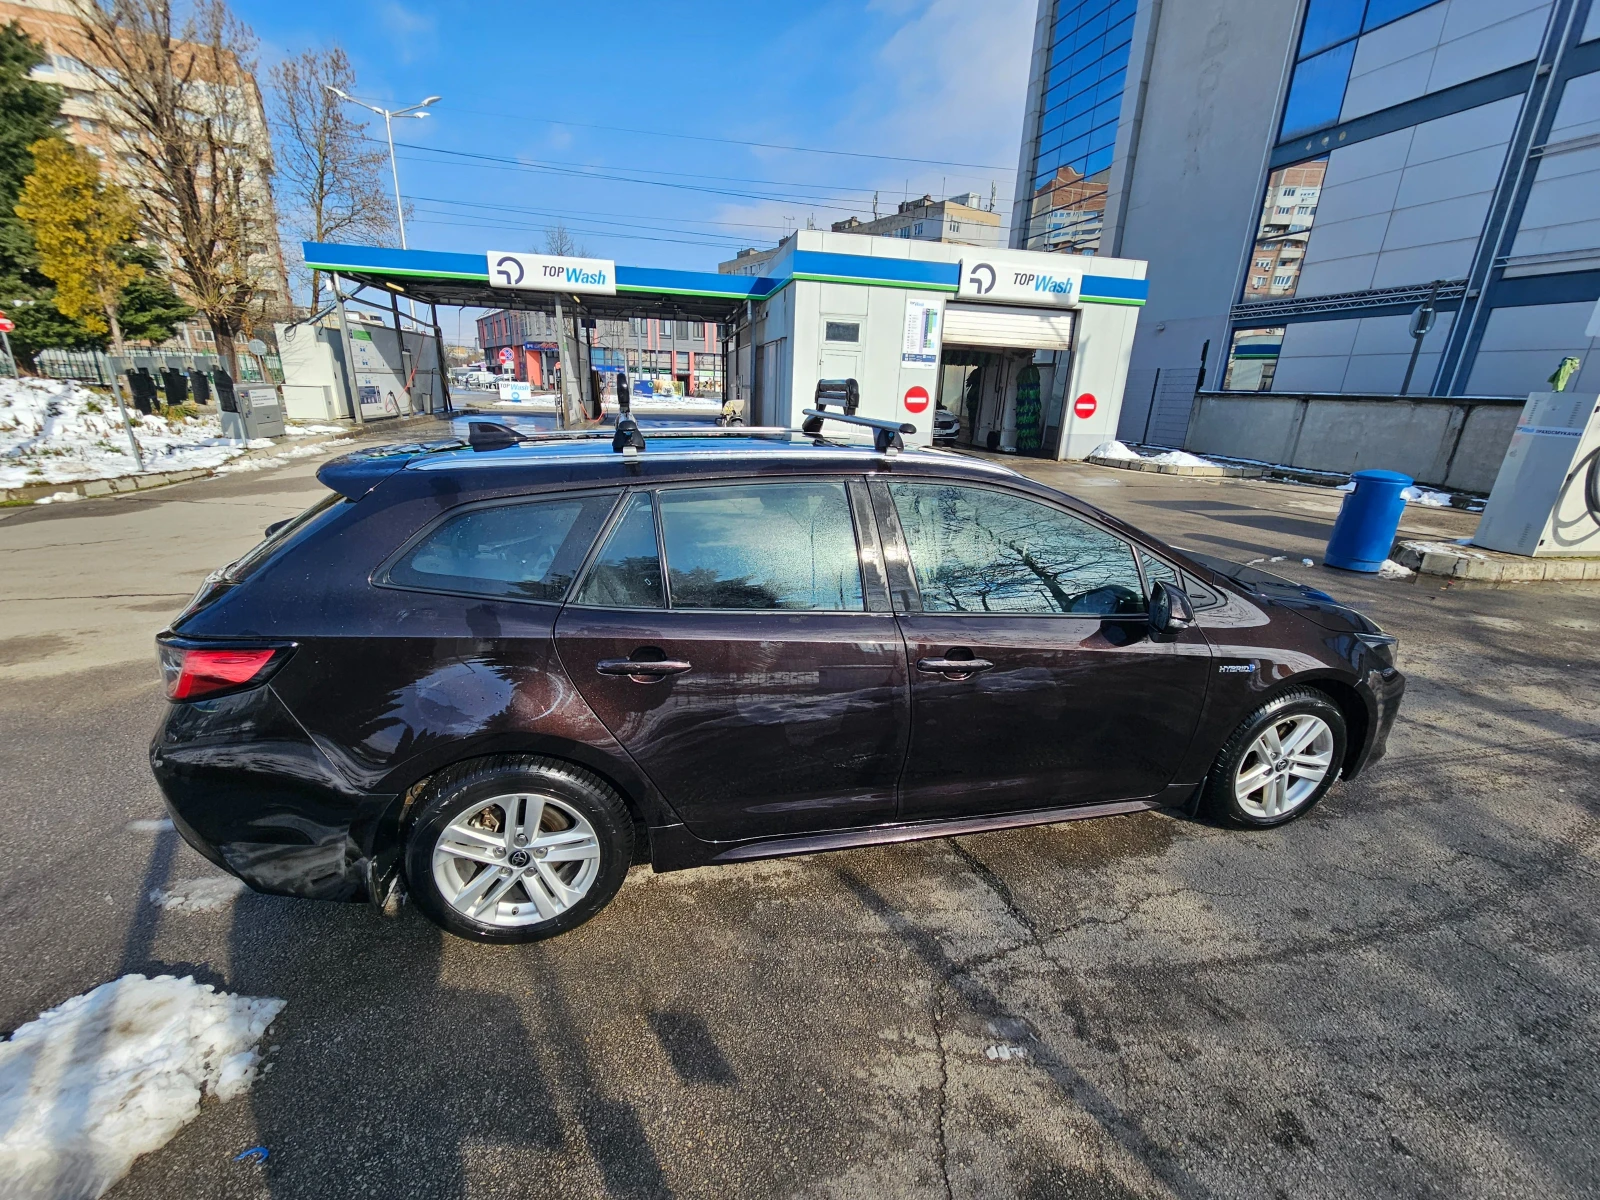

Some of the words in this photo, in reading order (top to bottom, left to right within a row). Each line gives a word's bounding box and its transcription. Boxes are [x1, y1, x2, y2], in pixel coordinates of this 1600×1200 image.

[542, 265, 564, 278] TOP
[565, 267, 606, 285] Wash
[1013, 272, 1035, 286] TOP
[1035, 274, 1073, 294] Wash
[1218, 665, 1250, 673] HYBRID
